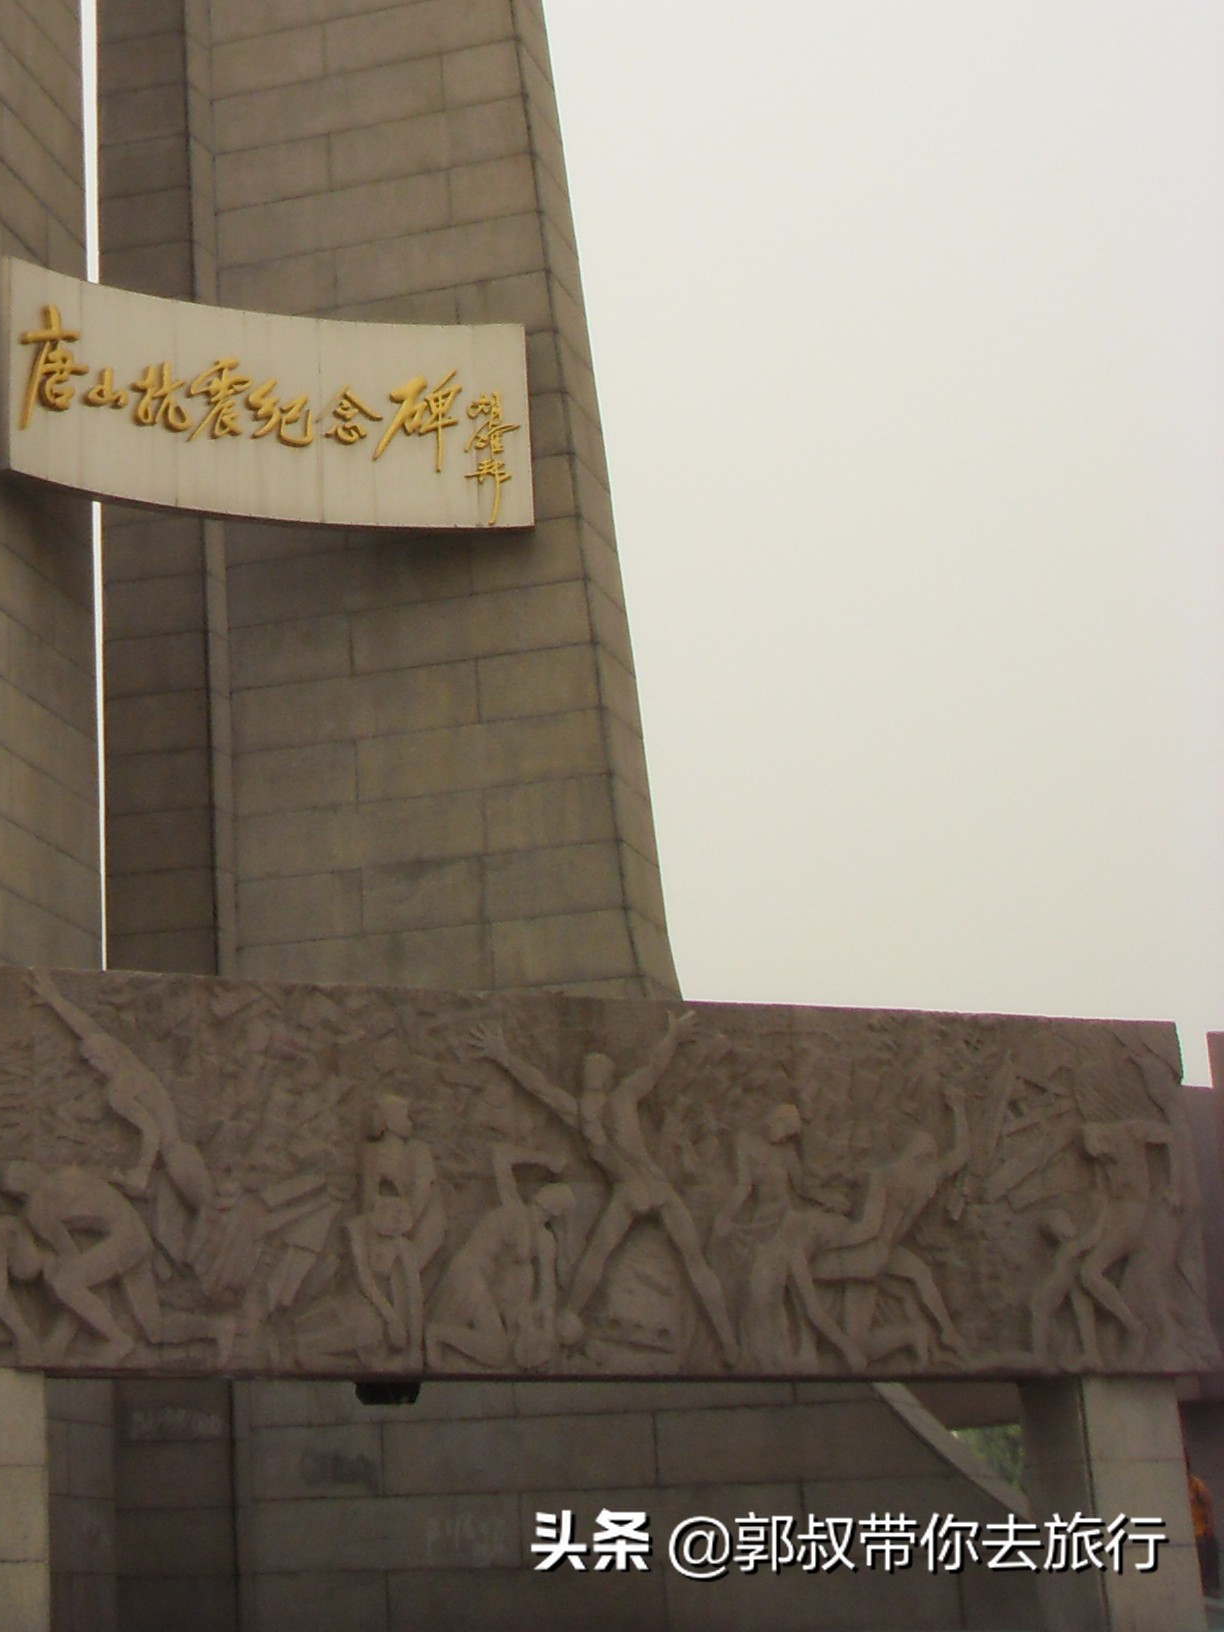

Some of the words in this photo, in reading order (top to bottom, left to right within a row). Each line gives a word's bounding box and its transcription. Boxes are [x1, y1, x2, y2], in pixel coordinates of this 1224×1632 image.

[18, 303, 464, 474] 唐山抗震纪念碑
